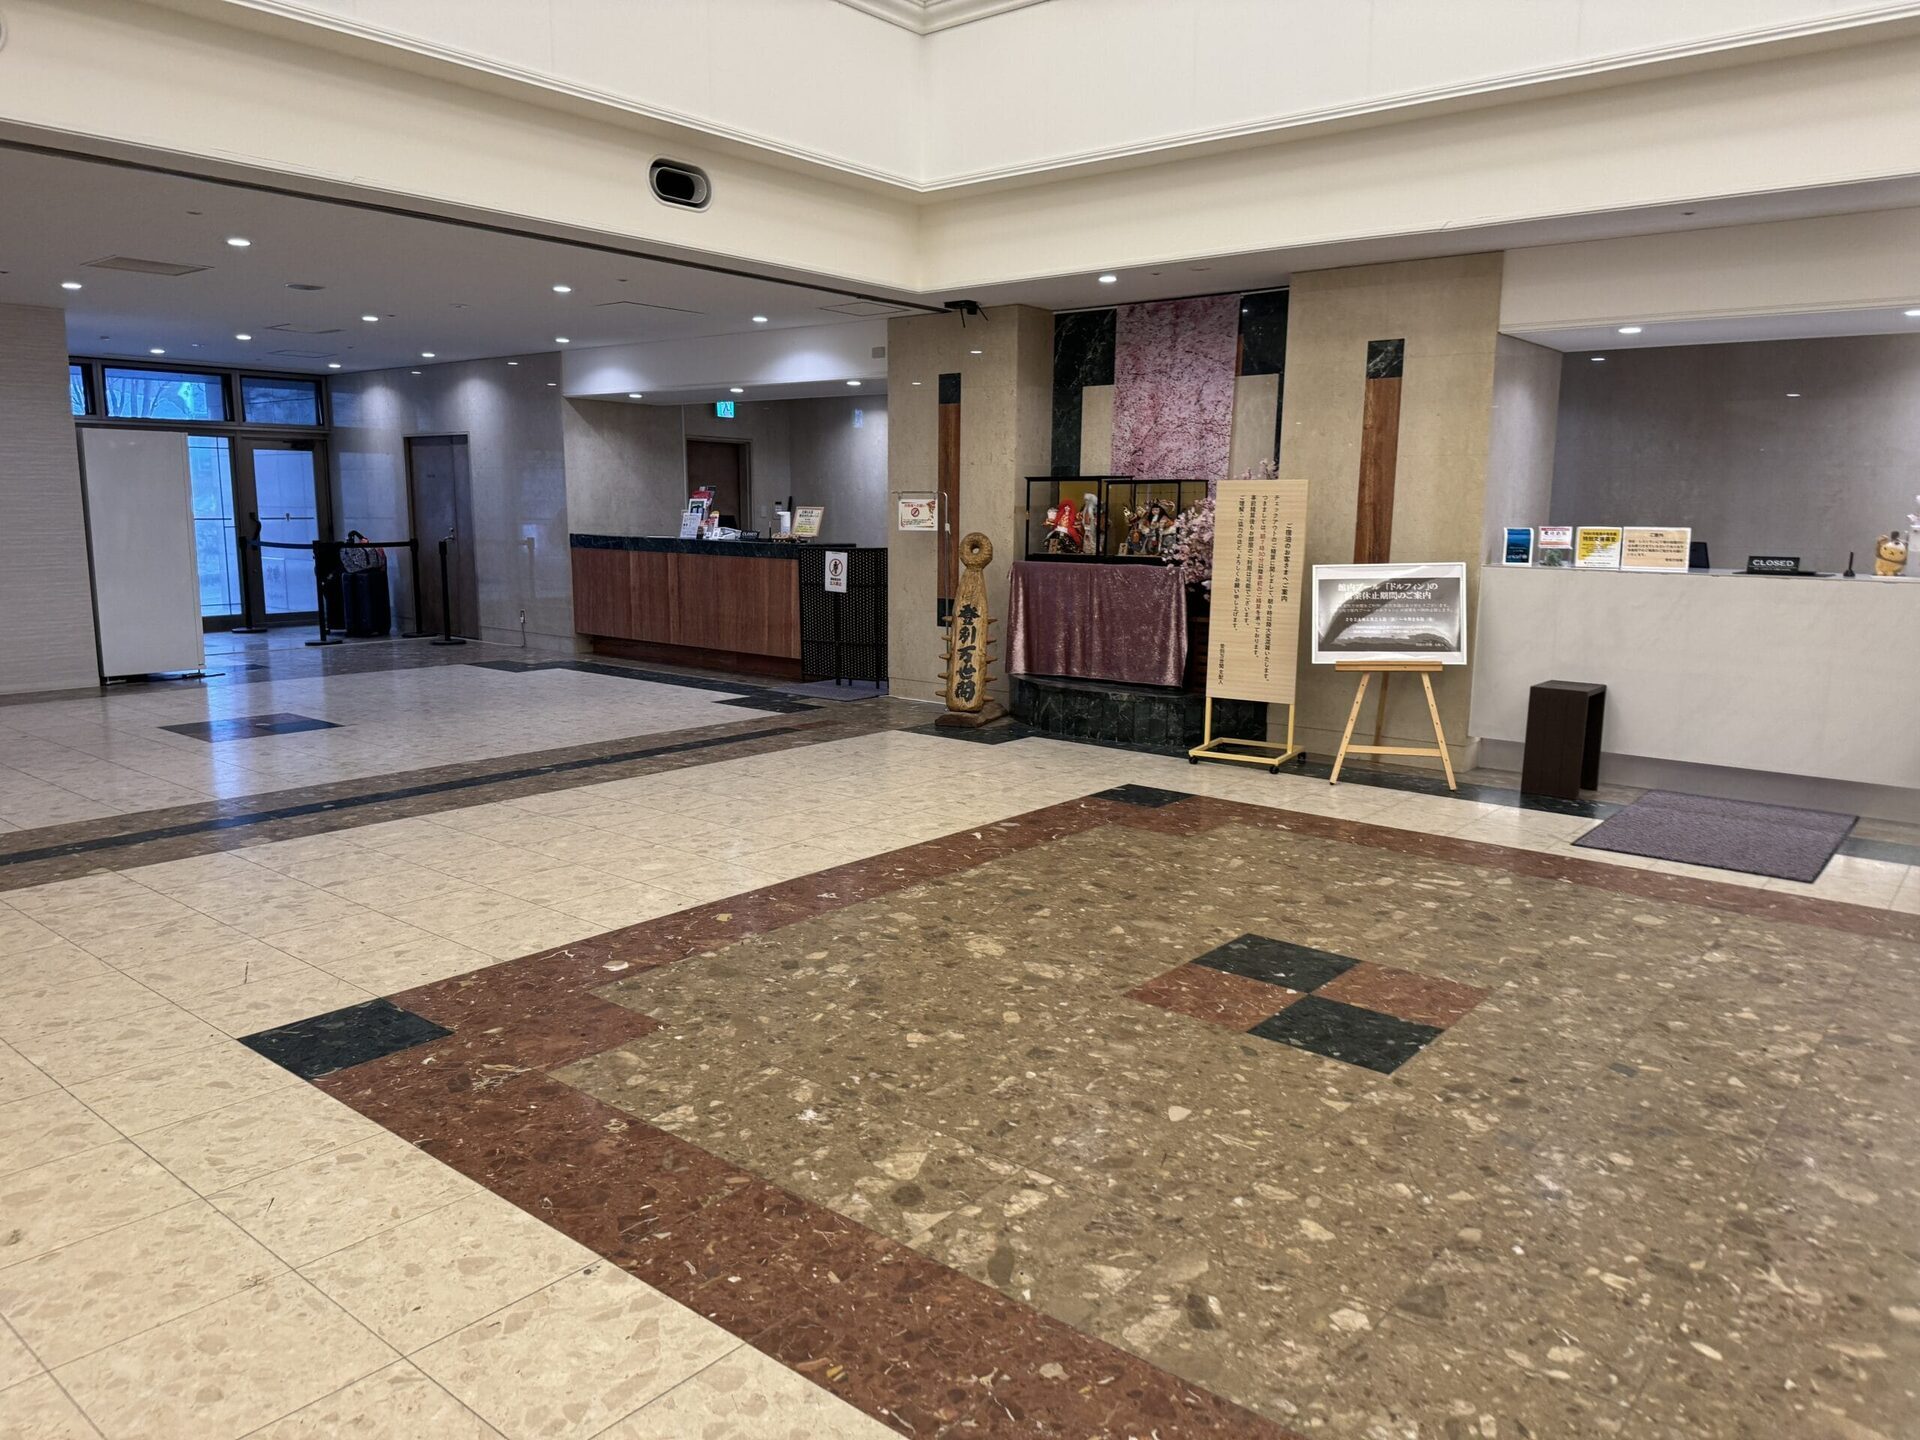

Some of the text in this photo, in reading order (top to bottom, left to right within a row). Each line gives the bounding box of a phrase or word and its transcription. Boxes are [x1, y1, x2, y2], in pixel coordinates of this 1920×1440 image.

[1280, 522, 1293, 602] ご宿泊のお客さまへご案内
[1752, 559, 1794, 567] CLOSED
[955, 603, 980, 703] 登別万世閣
